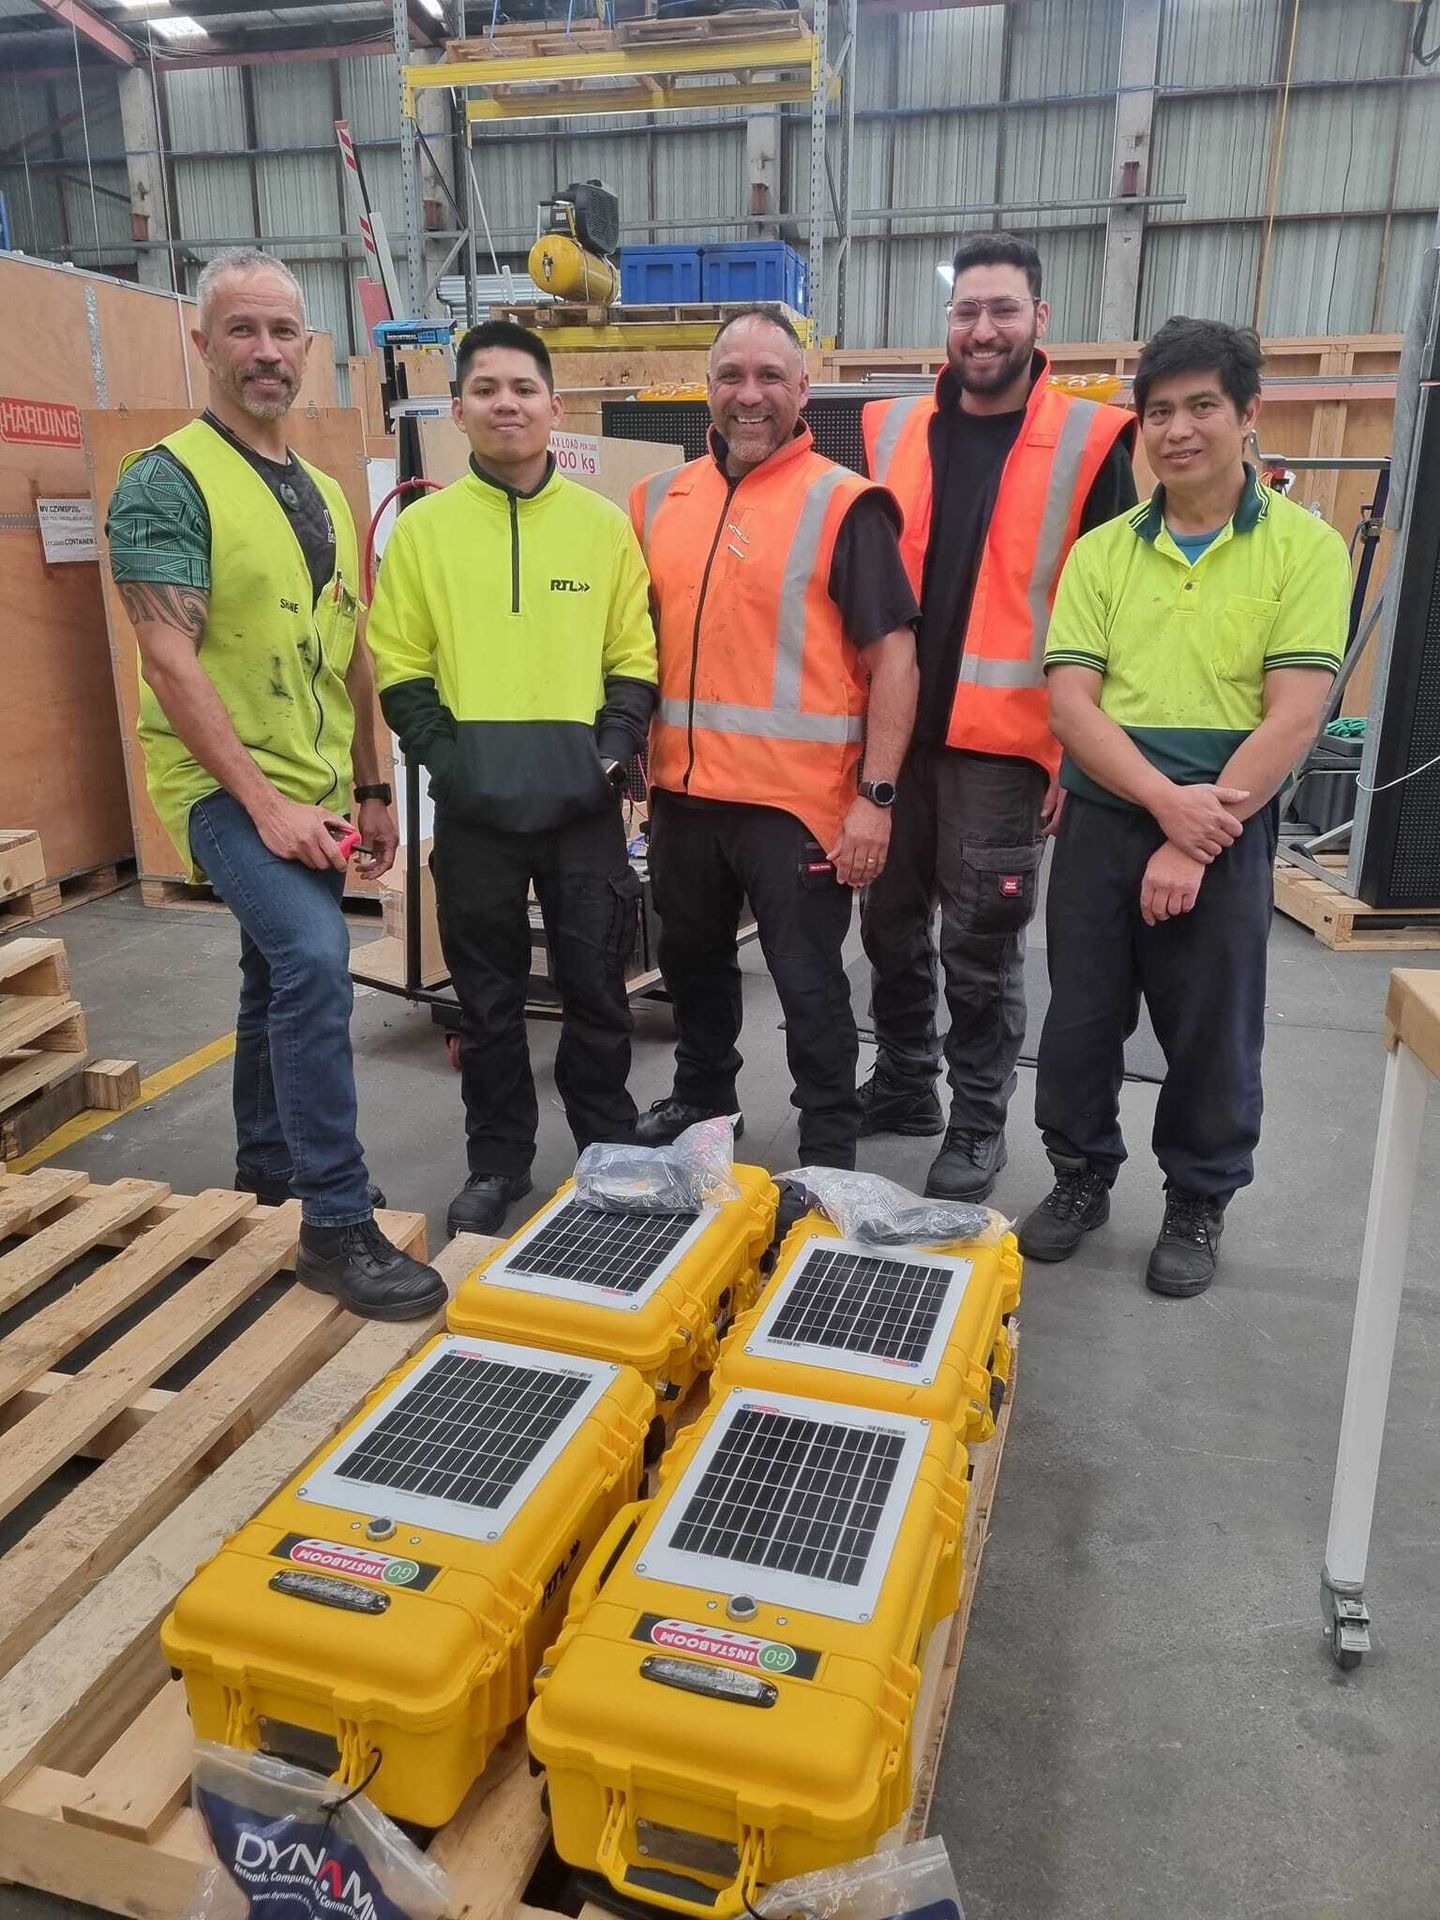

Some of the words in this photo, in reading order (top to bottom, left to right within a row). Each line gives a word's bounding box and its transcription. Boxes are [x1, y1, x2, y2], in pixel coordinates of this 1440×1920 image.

[1, 402, 79, 439] HARDING
[550, 437, 560, 448] AX
[561, 438, 579, 449] LOAD
[554, 450, 577, 469] 00
[581, 452, 596, 474] kg
[296, 1550, 383, 1577] INSTABOOM
[388, 1564, 413, 1580] GO
[659, 1631, 756, 1662] INSTABOOM
[763, 1649, 790, 1667] GO
